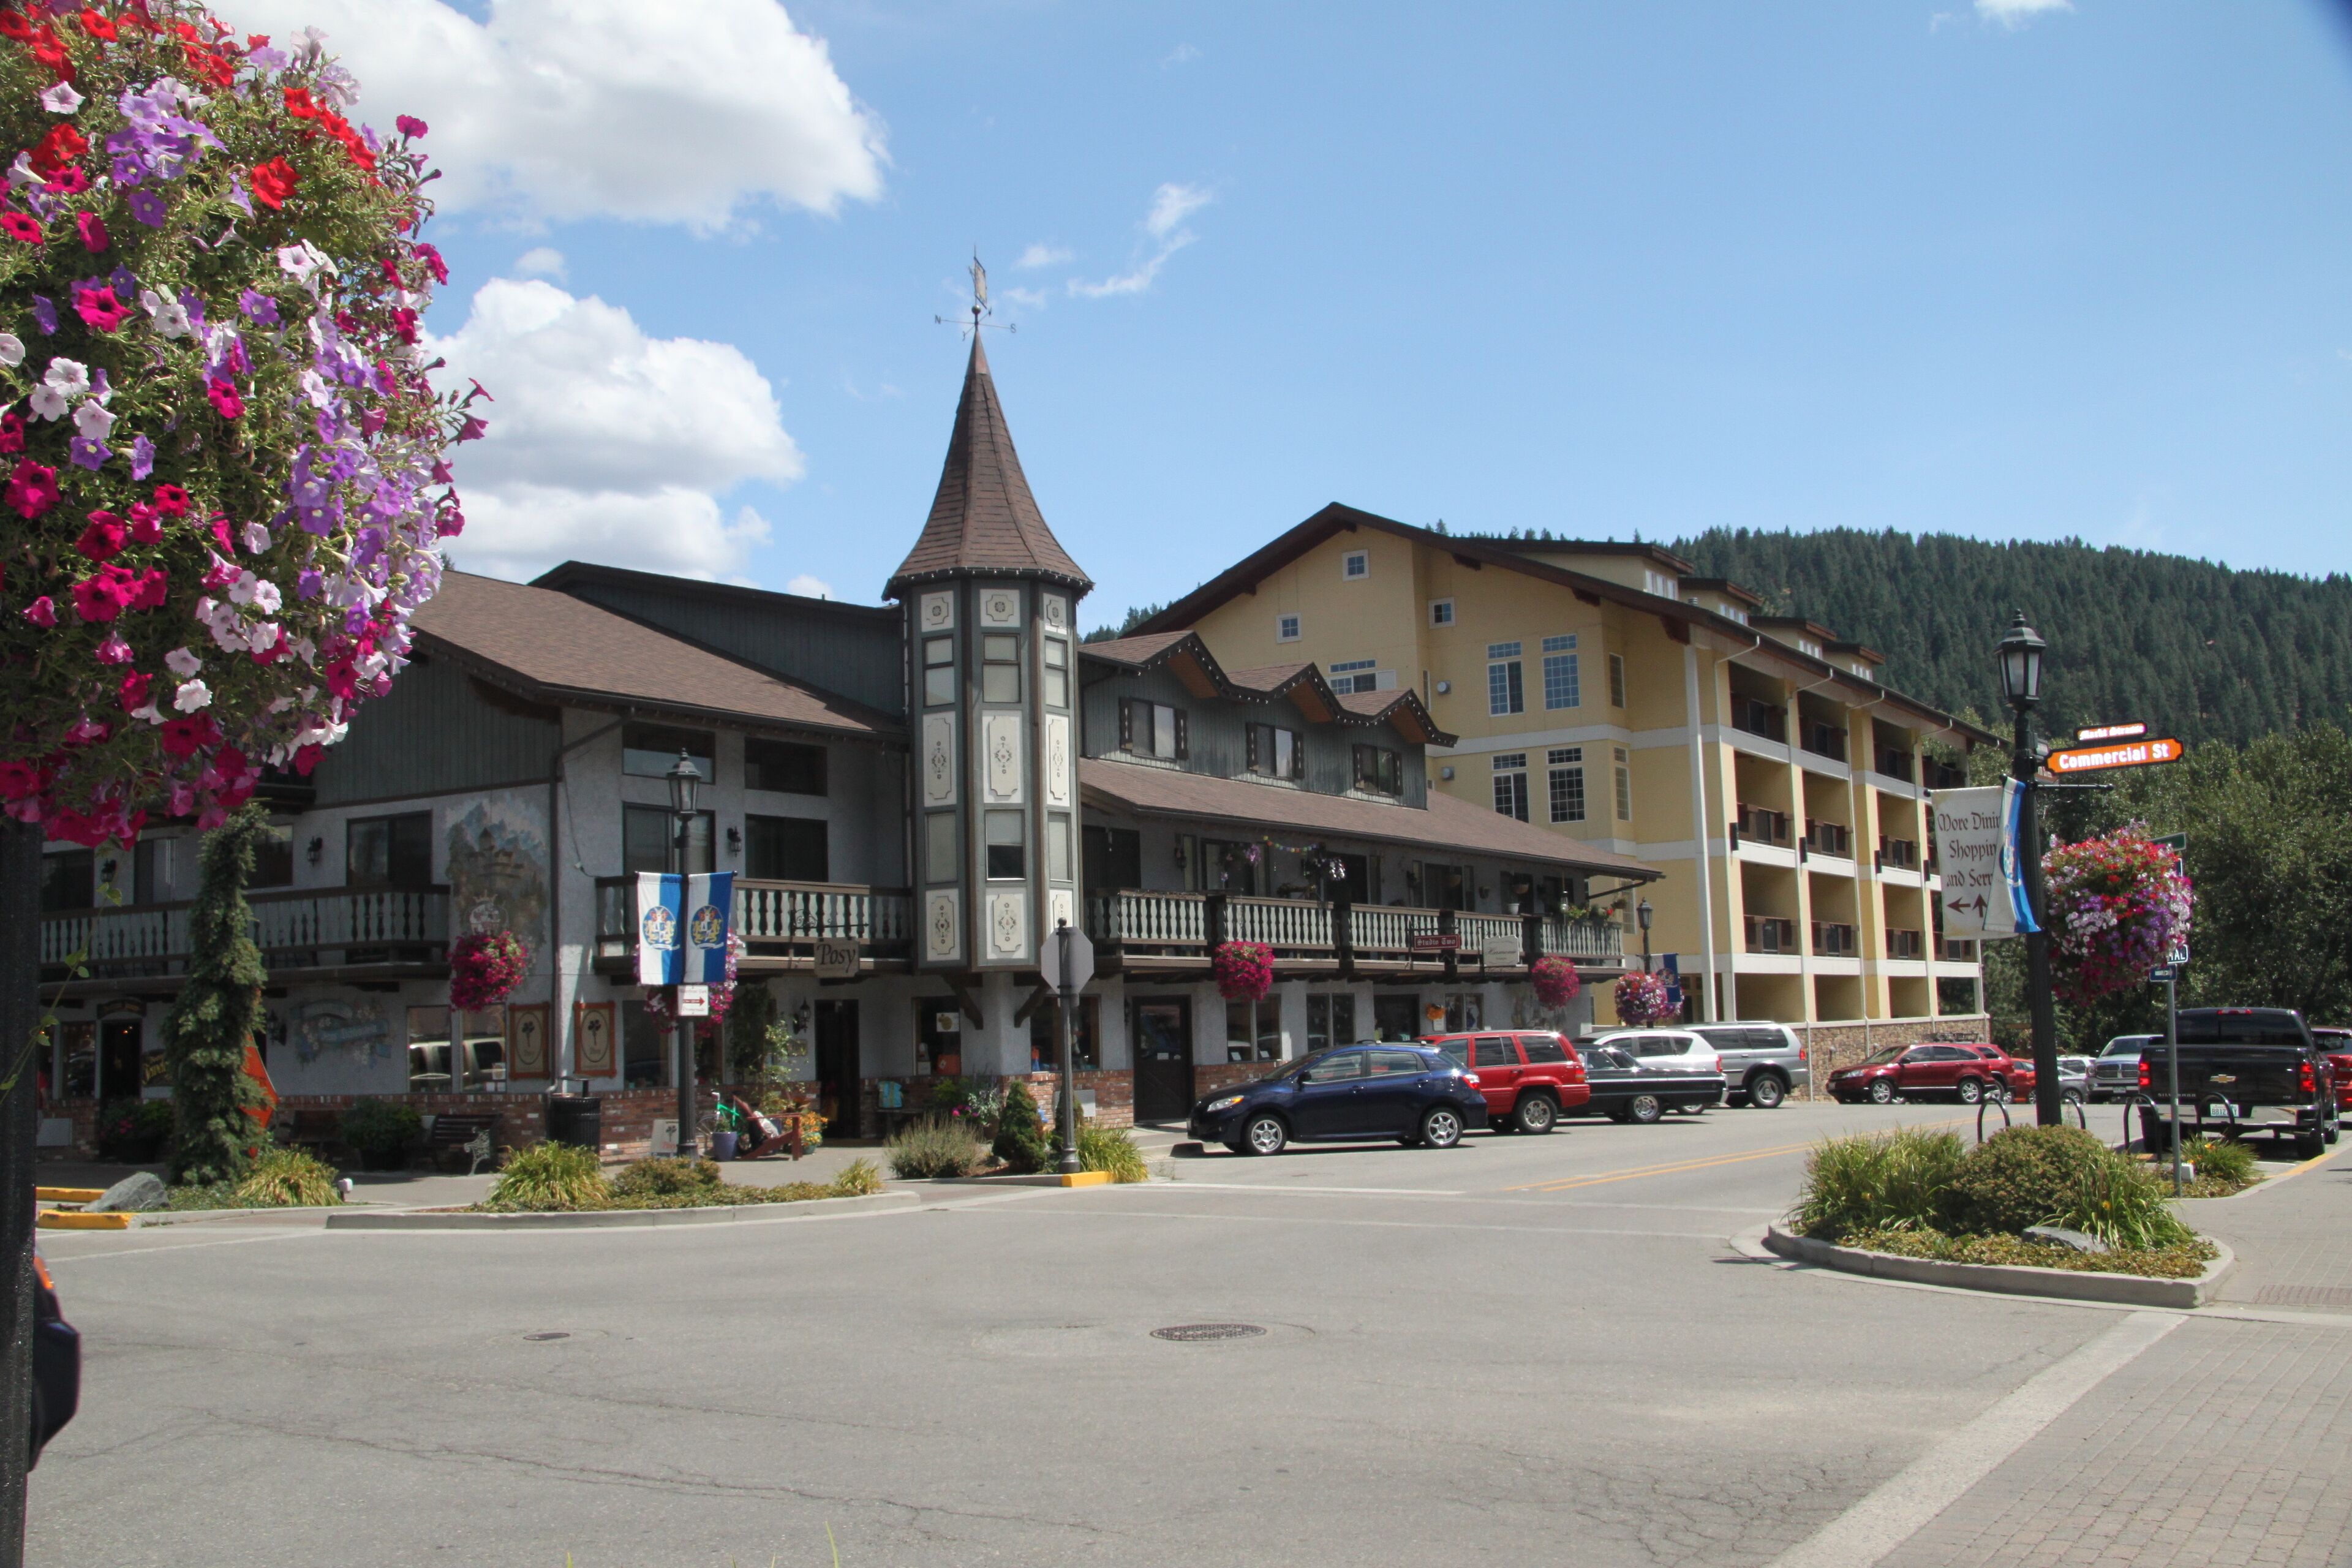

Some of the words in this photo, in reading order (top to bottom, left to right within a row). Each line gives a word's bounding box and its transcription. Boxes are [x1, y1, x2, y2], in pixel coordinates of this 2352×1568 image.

[2059, 745, 2146, 769] Commercial
[2152, 743, 2169, 759] St
[1937, 813, 1968, 832] More
[1970, 811, 2000, 830] Dinin
[1949, 839, 1997, 861] Shoppin
[1947, 870, 1965, 887] and
[816, 944, 856, 973] Posy
